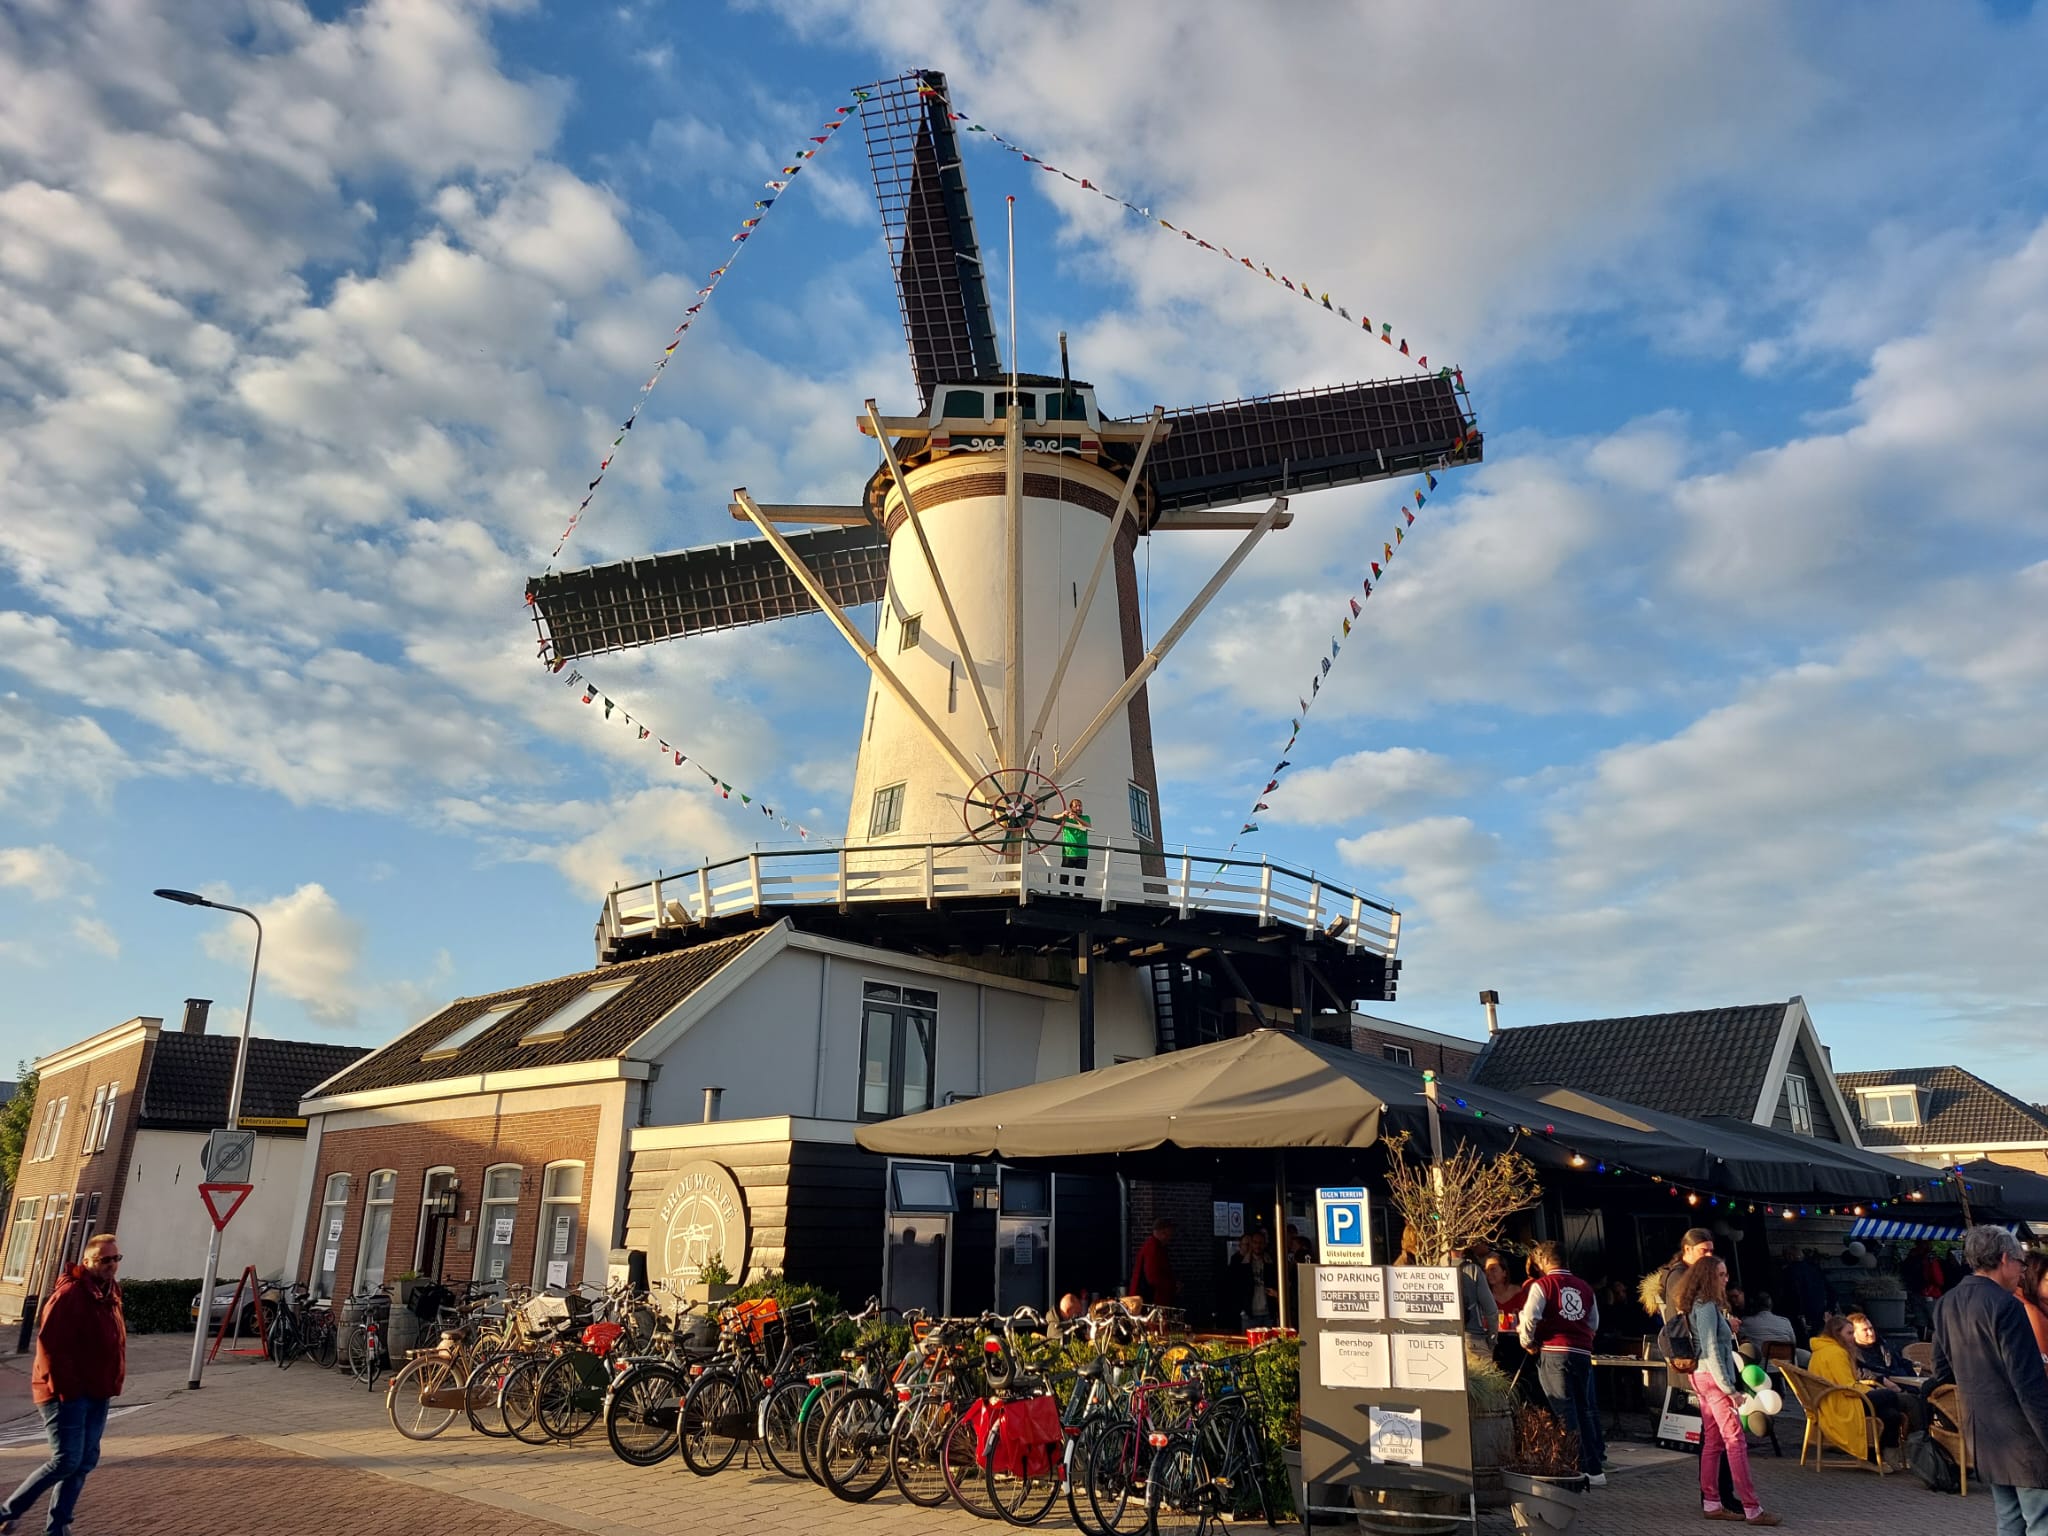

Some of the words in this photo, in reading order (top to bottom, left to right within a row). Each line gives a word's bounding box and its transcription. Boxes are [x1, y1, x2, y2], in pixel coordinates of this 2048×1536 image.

[660, 1172, 739, 1224] BROUWCAFÉ
[1332, 1207, 1354, 1241] P
[1326, 1250, 1365, 1258] Uitsluitend
[1319, 1273, 1334, 1282] NO
[1337, 1273, 1380, 1283] PARKING
[1394, 1272, 1408, 1280] WE
[1410, 1272, 1426, 1280] ARE
[1428, 1272, 1450, 1281] ONLY
[1402, 1282, 1425, 1291] OPEN
[1427, 1283, 1445, 1291] FOR
[1321, 1291, 1357, 1301] BOREFTS
[1359, 1291, 1380, 1301] BEER
[1393, 1292, 1431, 1302] BOREFTS
[1433, 1293, 1455, 1303] BEER
[1332, 1302, 1369, 1312] FESTIVAL
[1405, 1303, 1444, 1313] FESTIVAL
[1335, 1338, 1373, 1349] Beershop
[1407, 1339, 1445, 1350] TOILETS
[1338, 1348, 1370, 1357] Entrance
